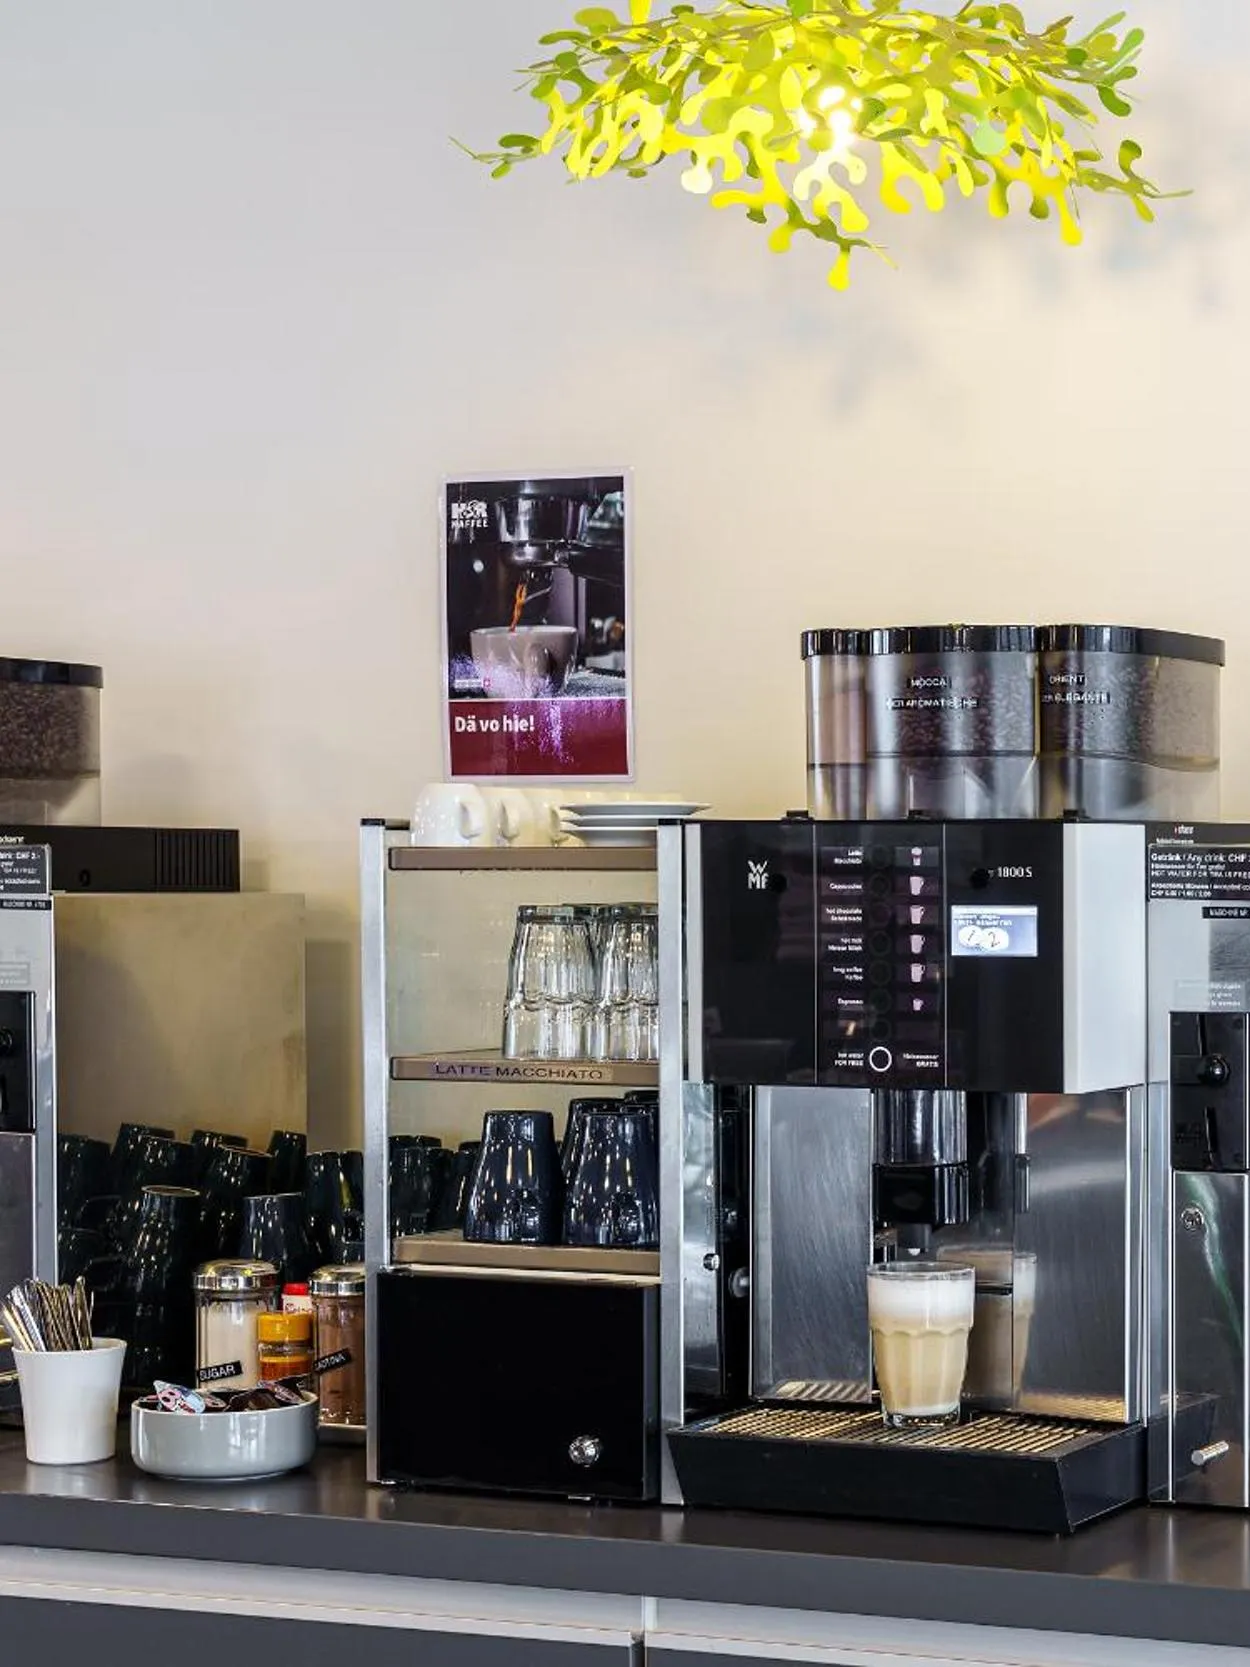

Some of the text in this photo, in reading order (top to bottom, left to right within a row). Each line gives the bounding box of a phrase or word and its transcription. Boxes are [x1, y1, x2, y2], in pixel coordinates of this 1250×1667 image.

[911, 677, 947, 688] MOCCA
[454, 714, 535, 733] Dä vo hie!
[1227, 853, 1247, 863] CHF
[997, 865, 1024, 878] 1800
[435, 1064, 603, 1080] LATTE MACCHIATO
[199, 1363, 236, 1381] SUGAR
